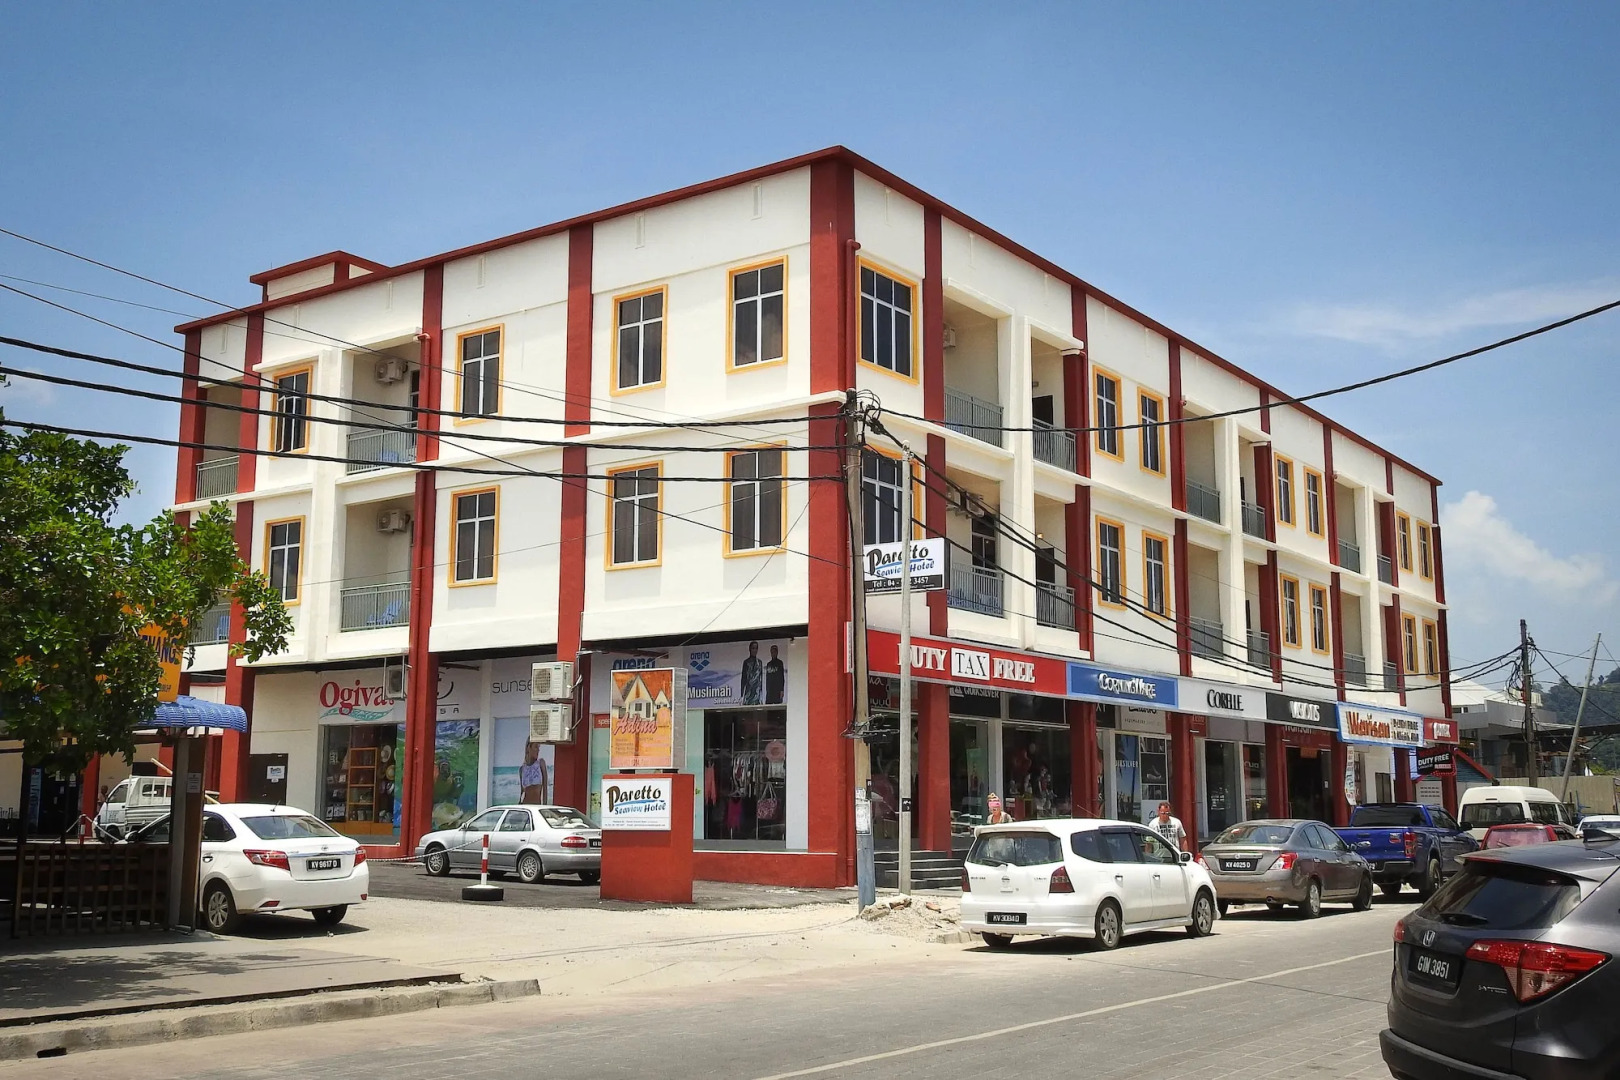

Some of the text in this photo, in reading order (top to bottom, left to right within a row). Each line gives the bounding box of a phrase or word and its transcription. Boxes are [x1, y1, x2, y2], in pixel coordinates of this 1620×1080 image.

[866, 544, 929, 576] Pareto
[875, 560, 935, 578] Seavie Hotel
[872, 580, 882, 588] Tel
[914, 576, 929, 585] 3457
[689, 651, 710, 660] arena
[955, 652, 987, 677] TAX
[992, 657, 1036, 684] FREE
[319, 679, 395, 716] Ogiva
[687, 685, 732, 699] Muslimah
[1206, 689, 1243, 711] CORELLE
[613, 712, 658, 735] Adina
[1418, 753, 1450, 766] DUTY FREE
[606, 785, 662, 813] Paretto
[614, 802, 667, 815] Seaview Hotel
[1430, 959, 1450, 979] 3851
